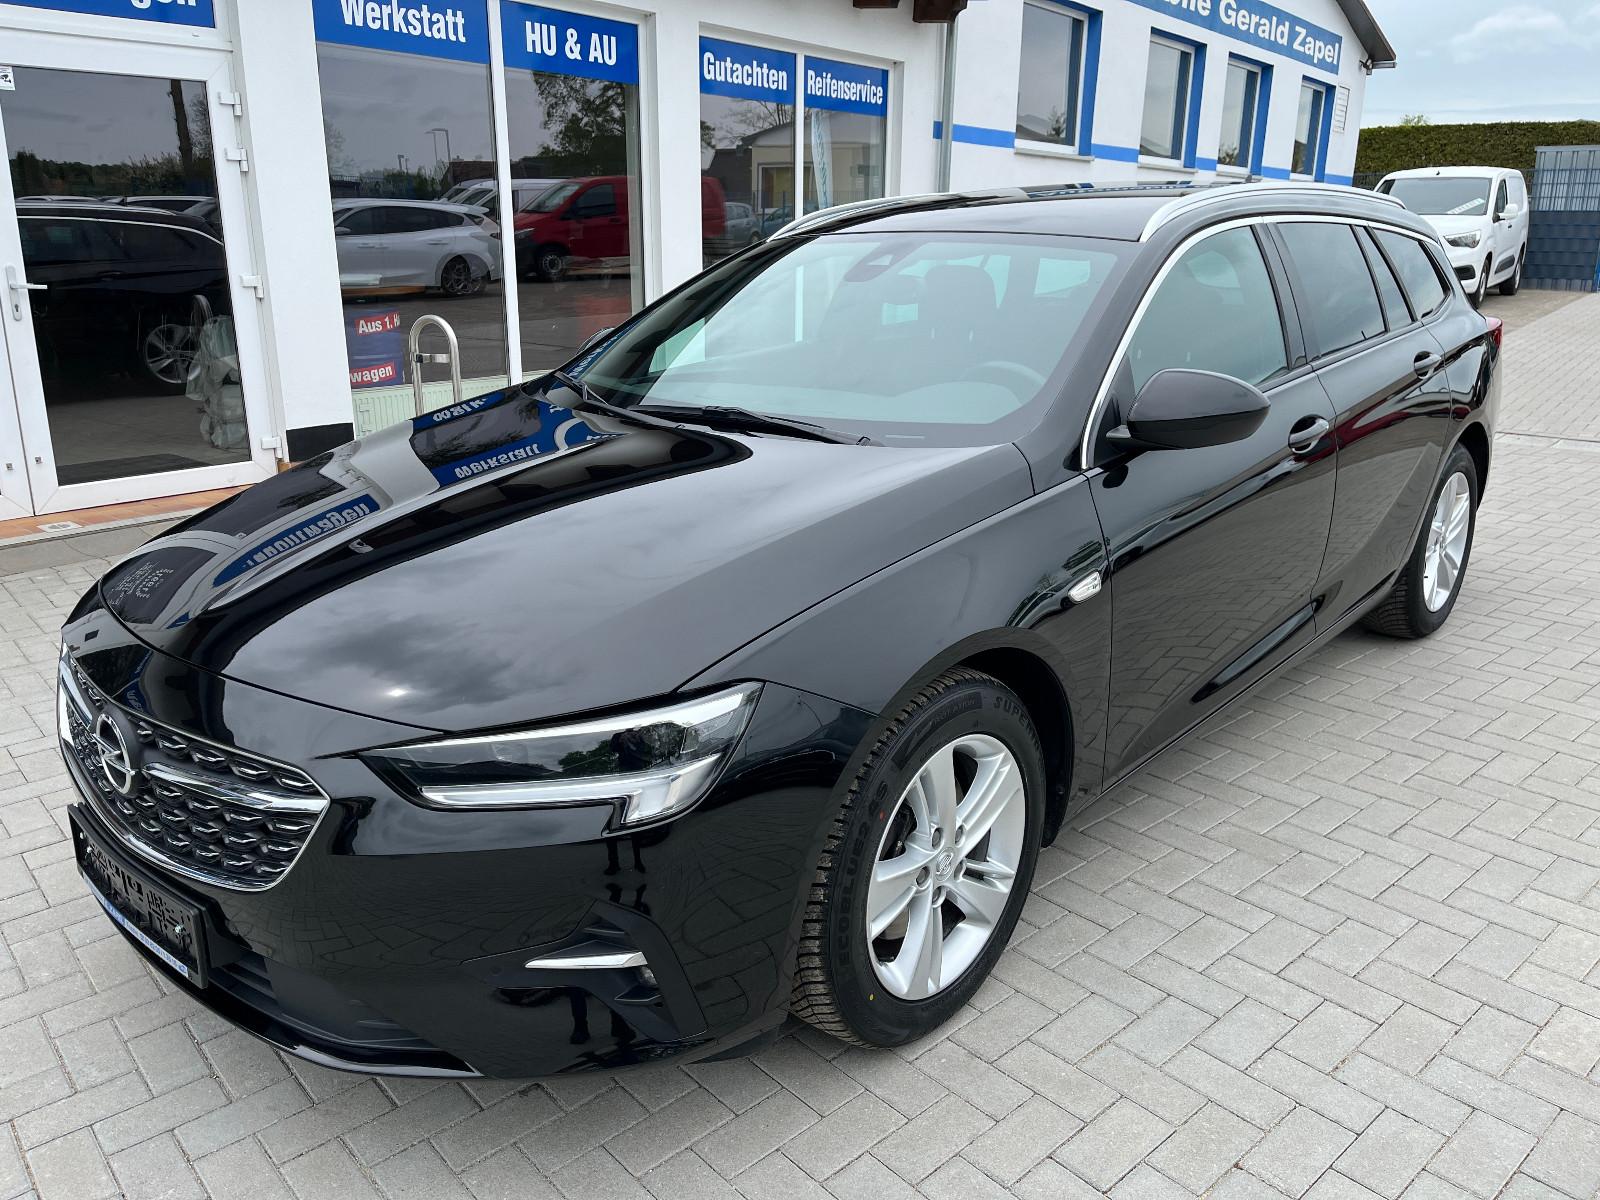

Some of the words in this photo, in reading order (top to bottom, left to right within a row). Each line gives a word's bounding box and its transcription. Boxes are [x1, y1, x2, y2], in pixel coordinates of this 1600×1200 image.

[340, 0, 467, 43] Werkstatt
[1219, 0, 1289, 46] Gerald
[1293, 26, 1339, 65] Zapel
[525, 21, 556, 57] HU
[564, 27, 582, 61] &
[588, 33, 617, 66] AU
[702, 51, 788, 92] Gutachten
[806, 68, 884, 105] Reifenservice
[359, 319, 382, 334] Aus
